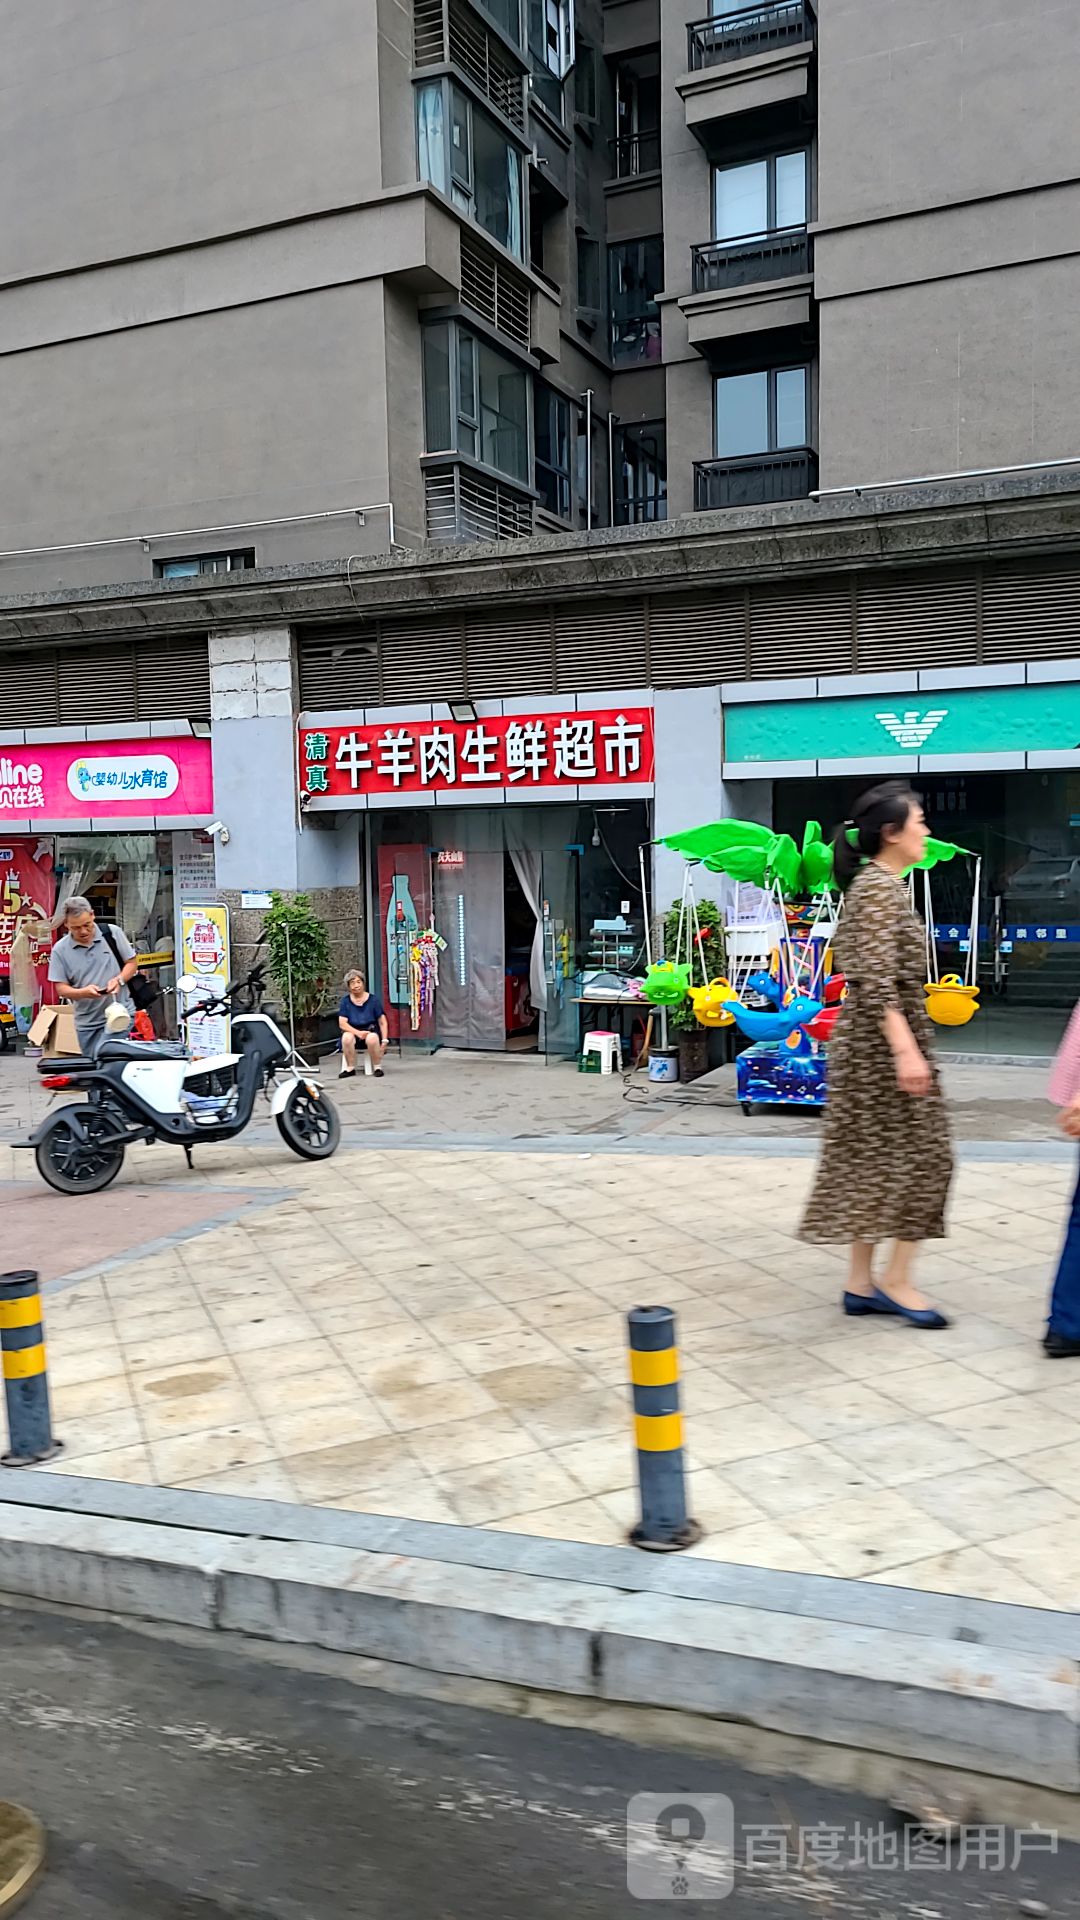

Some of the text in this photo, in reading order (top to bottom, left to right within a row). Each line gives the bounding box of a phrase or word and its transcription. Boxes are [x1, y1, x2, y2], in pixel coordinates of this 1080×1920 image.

[0, 757, 43, 785] line
[305, 733, 328, 791] 清真
[335, 714, 645, 789] 牛羊肉生鲜超市
[92, 768, 168, 790] 婴幼儿水育馆
